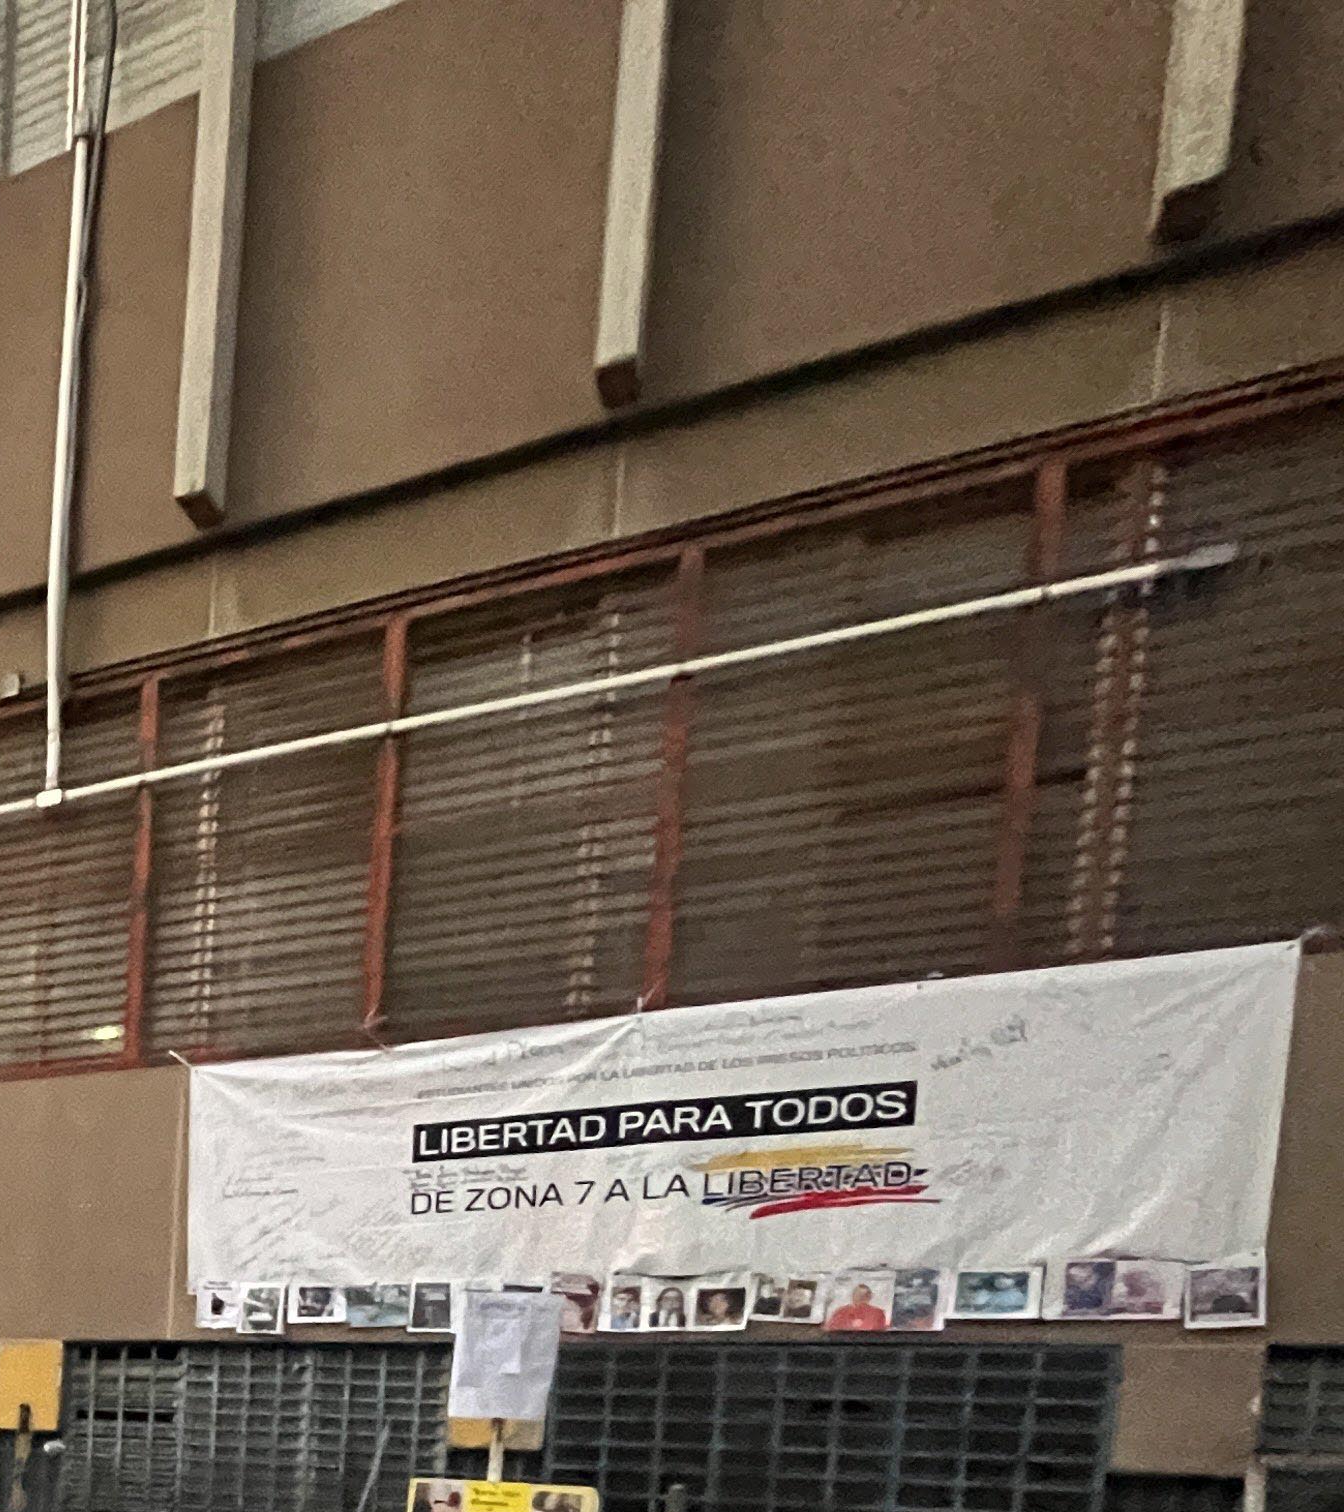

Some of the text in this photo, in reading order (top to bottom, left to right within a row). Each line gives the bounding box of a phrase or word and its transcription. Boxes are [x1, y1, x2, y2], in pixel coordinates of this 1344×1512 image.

[419, 1090, 907, 1156] LIBERTAD PARA TODOS
[410, 1161, 912, 1215] DE ZONA 7 A LA LIBERTAD
